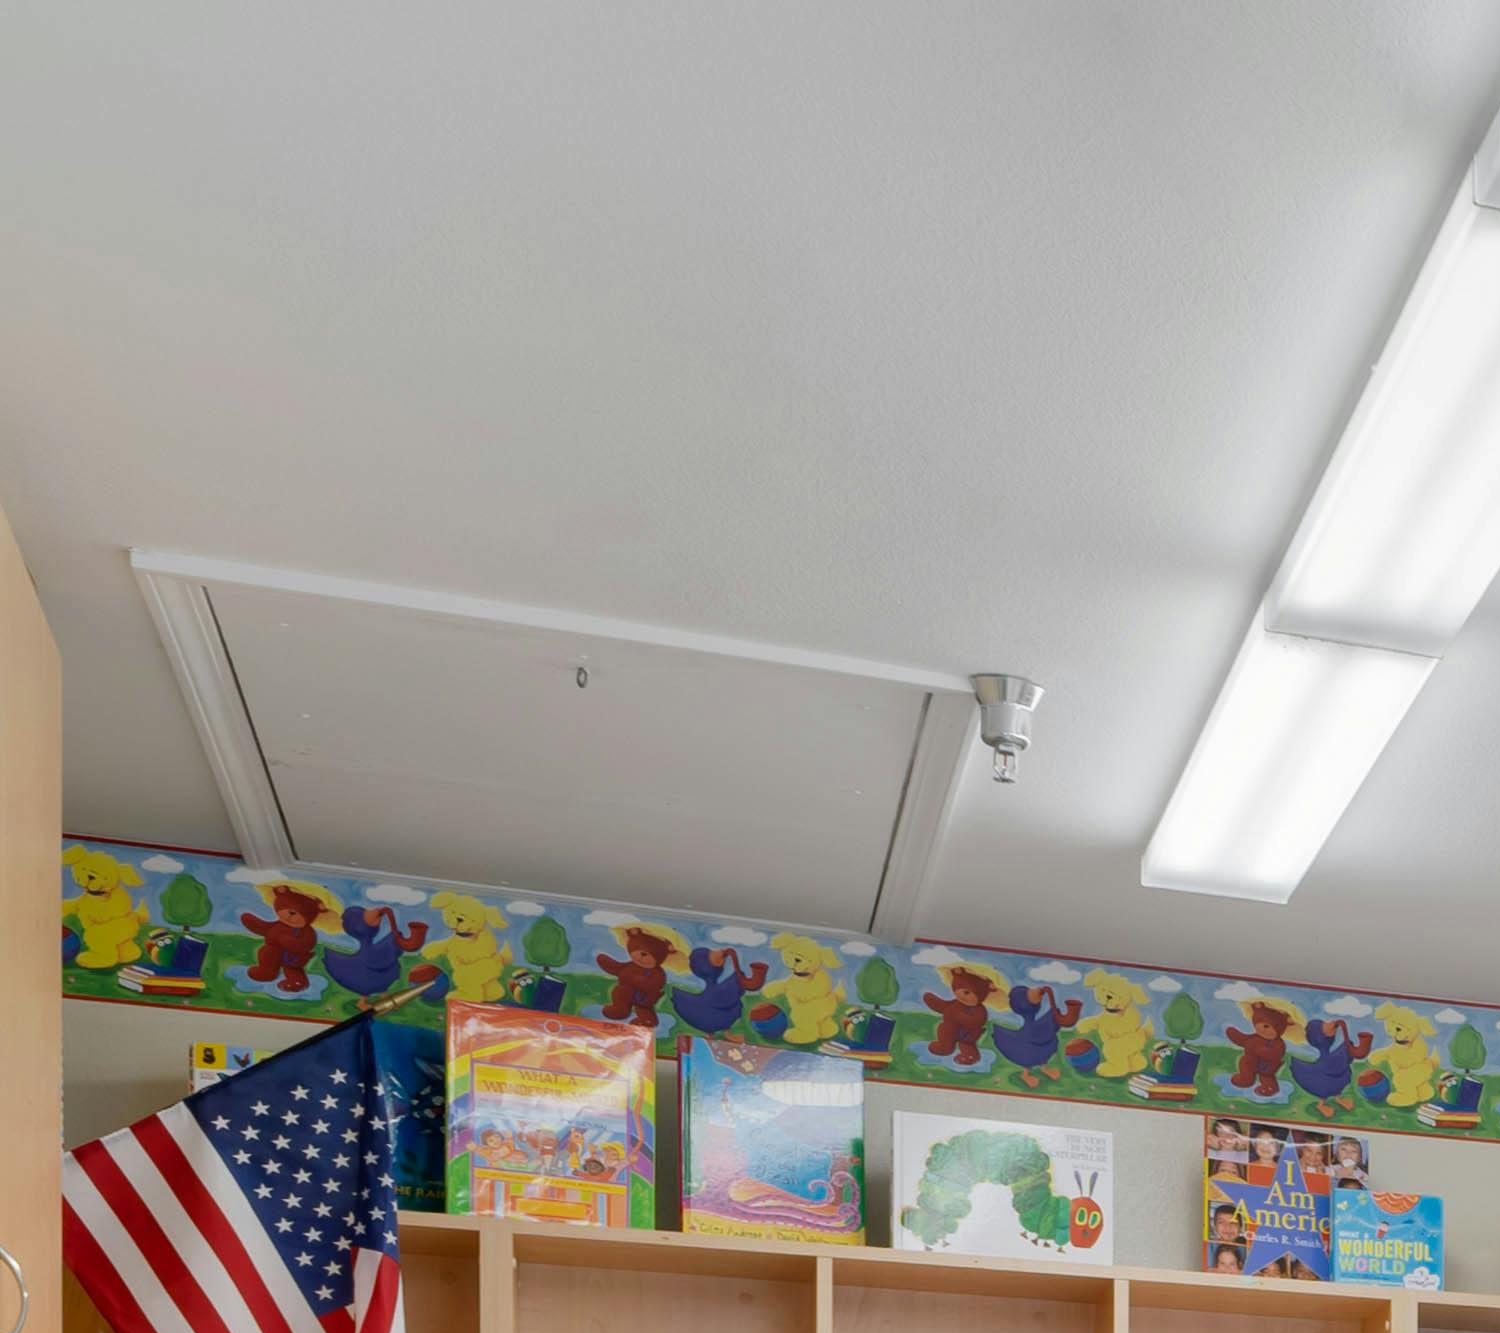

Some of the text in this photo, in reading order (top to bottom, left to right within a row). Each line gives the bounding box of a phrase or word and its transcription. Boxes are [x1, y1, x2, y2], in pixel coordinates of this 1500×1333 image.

[1284, 1160, 1295, 1186] I
[1264, 1181, 1315, 1210] Am
[1231, 1199, 1331, 1234] Americ
[1241, 1230, 1279, 1245] Charles
[1338, 1237, 1433, 1263] WONDERFUL
[1339, 1256, 1406, 1276] WORLD
